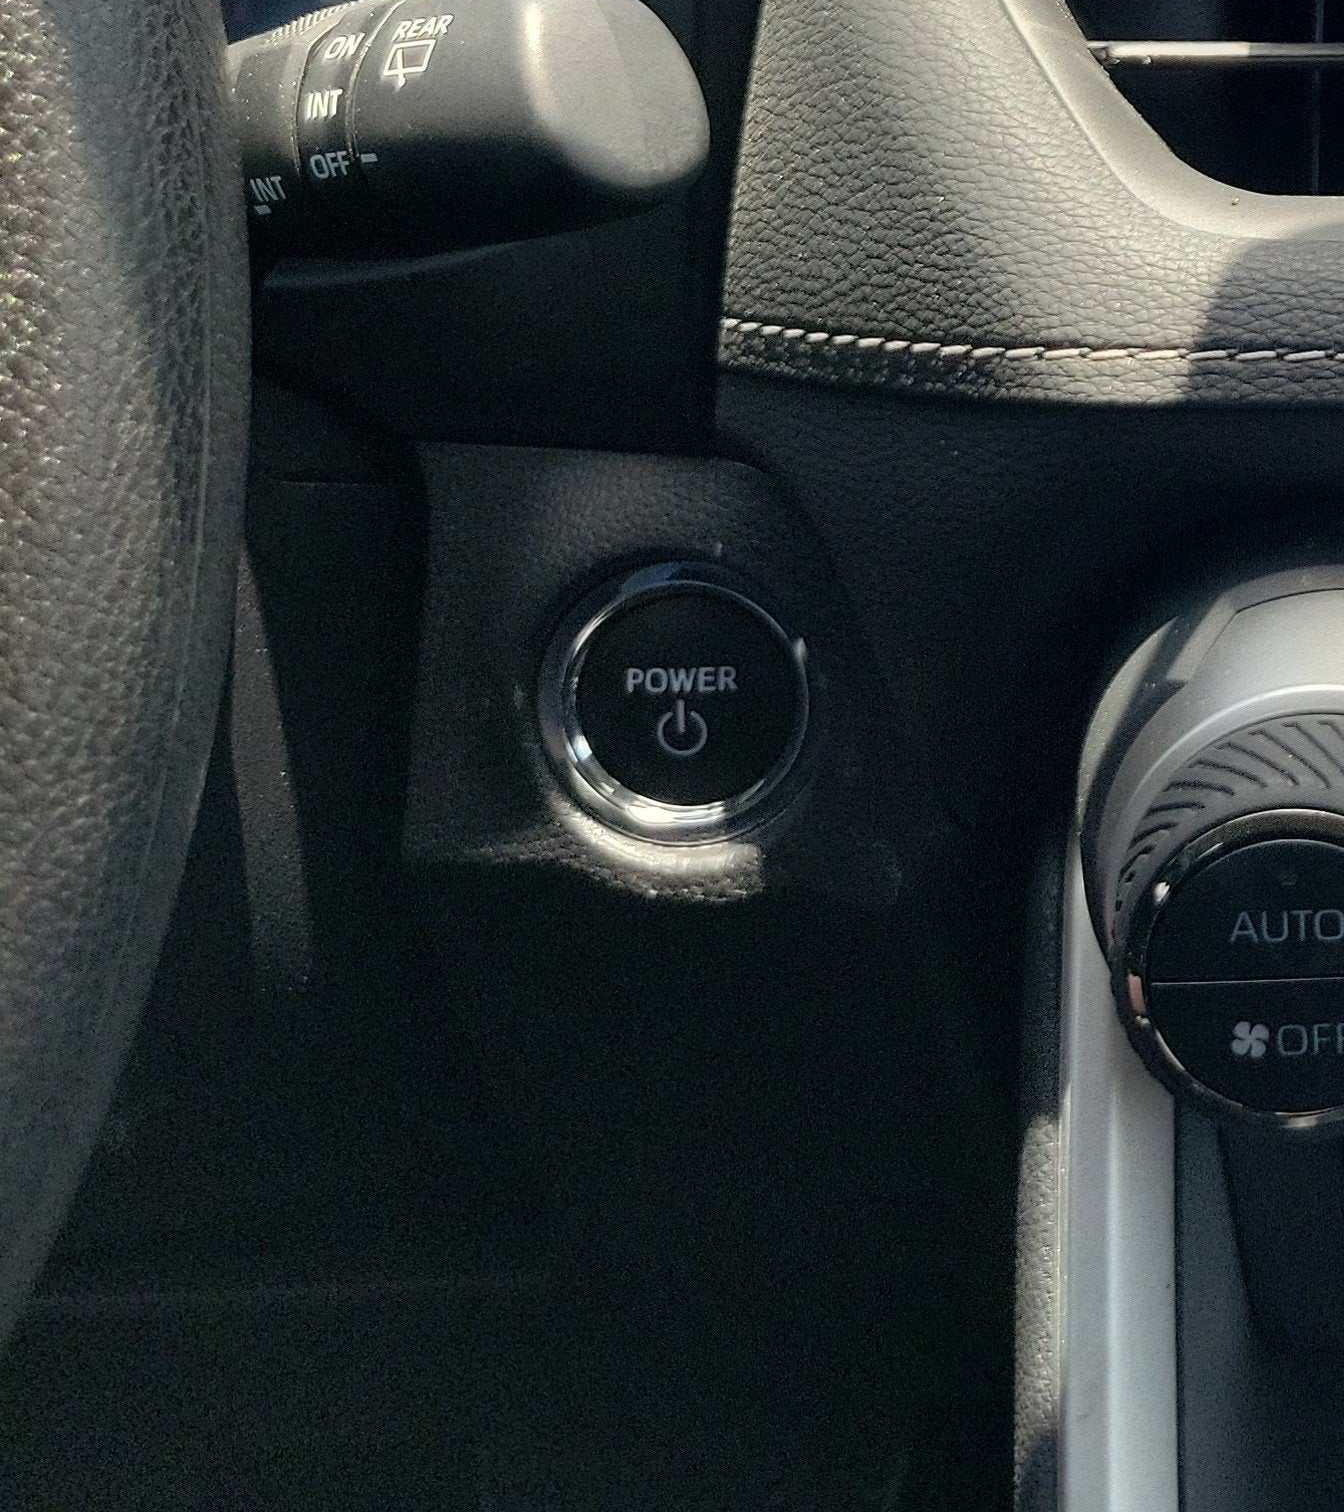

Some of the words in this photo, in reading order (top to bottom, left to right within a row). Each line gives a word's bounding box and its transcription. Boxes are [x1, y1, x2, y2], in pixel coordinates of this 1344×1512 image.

[391, 13, 453, 40] REAR
[324, 32, 365, 60] ON
[305, 88, 343, 120] INT
[309, 150, 351, 180] OFF
[249, 175, 287, 202] INT
[626, 666, 738, 693] POWER
